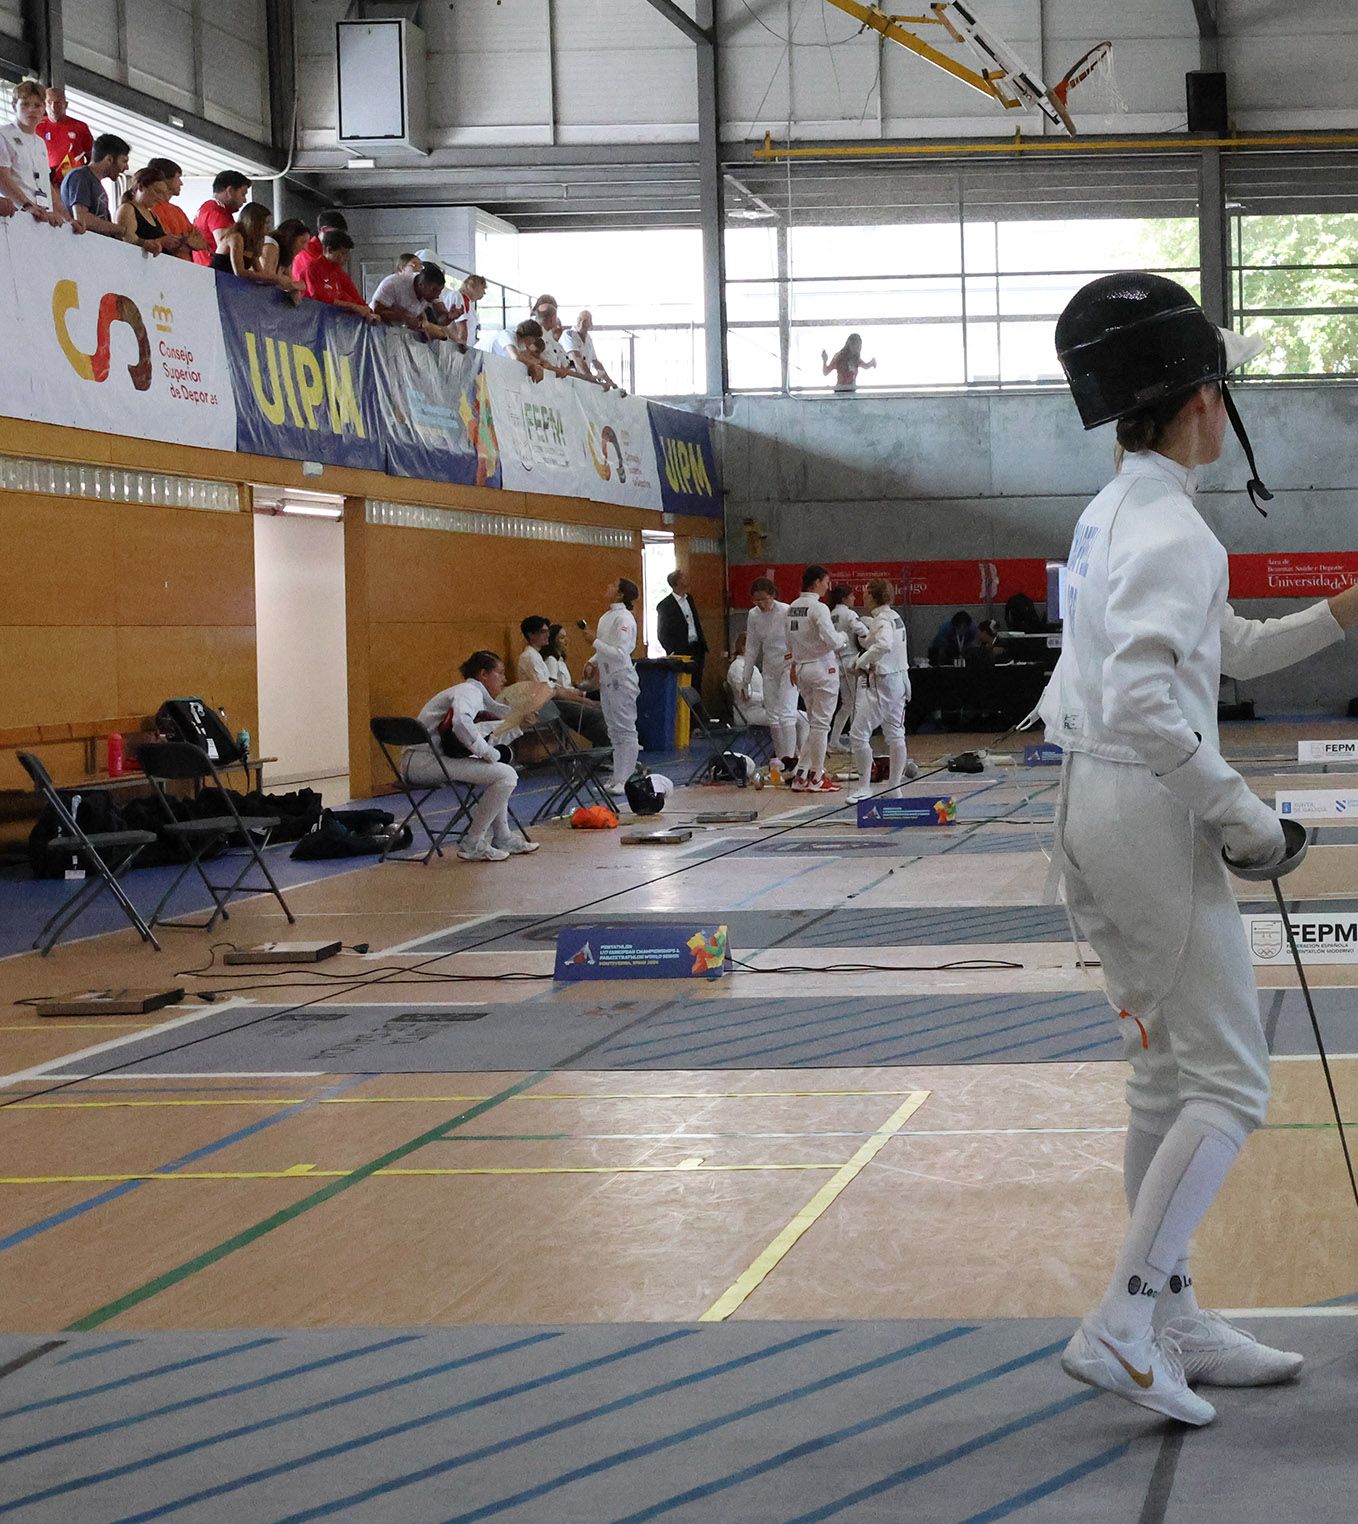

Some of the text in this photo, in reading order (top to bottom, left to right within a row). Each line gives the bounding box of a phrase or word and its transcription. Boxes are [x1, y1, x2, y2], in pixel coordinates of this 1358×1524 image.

[159, 340, 194, 365] Consejo
[162, 362, 202, 383] Superior
[181, 384, 218, 405] Depores
[245, 331, 366, 438] UIPM
[659, 436, 713, 497] UIPM
[1325, 743, 1356, 752] FEPM
[1286, 923, 1358, 942] FEPM
